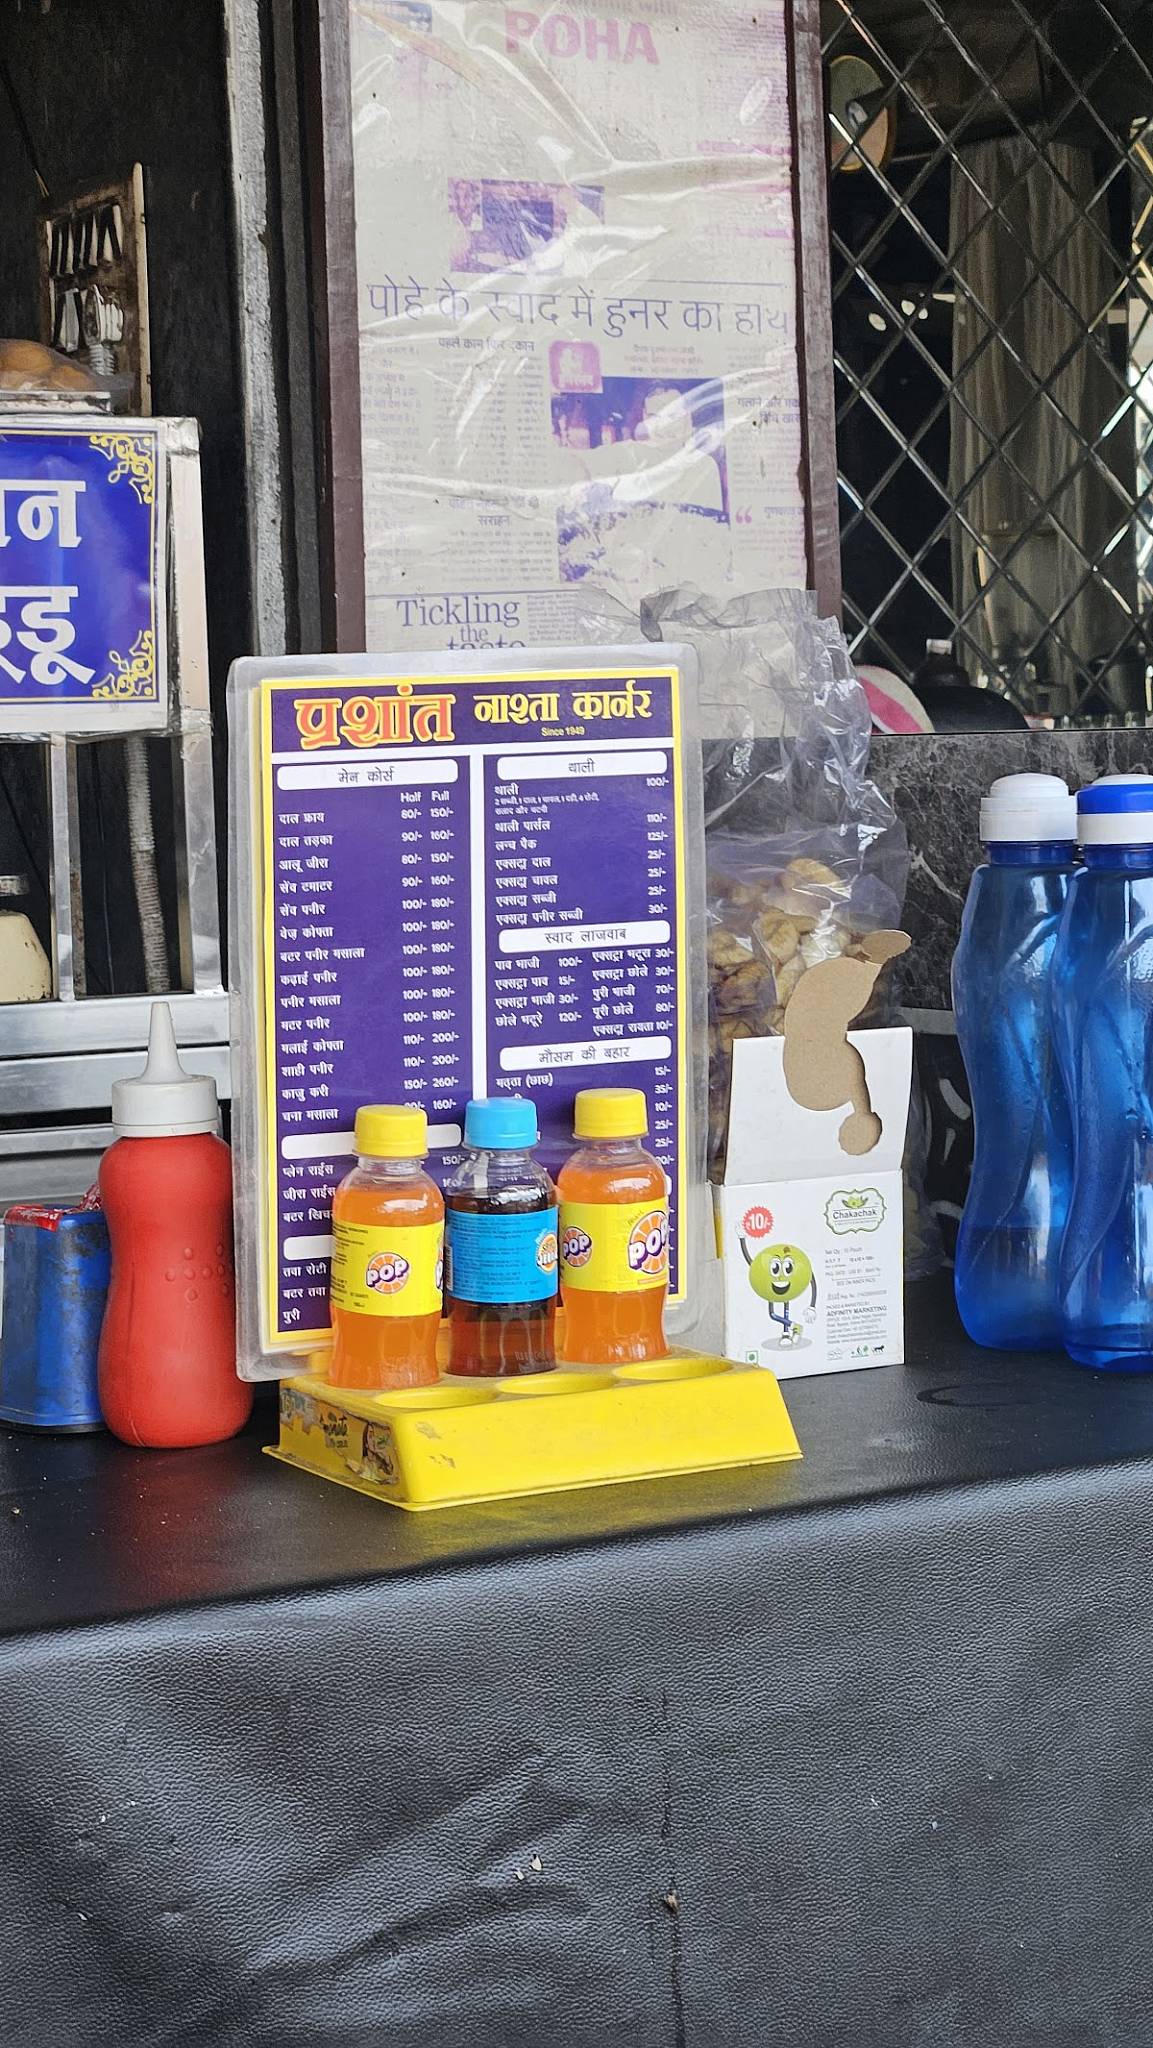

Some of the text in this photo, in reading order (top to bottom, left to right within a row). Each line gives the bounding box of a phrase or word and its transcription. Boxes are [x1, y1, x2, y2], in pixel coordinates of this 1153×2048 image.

[505, 8, 661, 66] POHA
[365, 273, 429, 320] पोहे
[570, 285, 596, 329] में
[604, 297, 673, 337] हुनर
[679, 301, 722, 332] का
[396, 596, 519, 627] Tickling
[460, 625, 488, 642] the
[293, 679, 653, 751] प्रशांत नाश्ता कार्नर
[541, 727, 564, 736] Since
[568, 757, 596, 774] थाली
[401, 791, 449, 802] Half Full
[279, 860, 303, 872] आलू
[402, 899, 427, 909] 100/-
[403, 921, 427, 932] 100/-
[544, 930, 575, 945] स्वाद
[403, 944, 427, 954] 100/-
[403, 967, 427, 977] 100/-
[403, 989, 427, 999] 100/-
[403, 1011, 428, 1022] 100/-
[432, 1032, 459, 1042] 200/-
[581, 1045, 596, 1061] की
[432, 1054, 459, 1065] 200/-
[833, 1209, 877, 1220] Chakachak
[366, 1258, 409, 1288] POP
